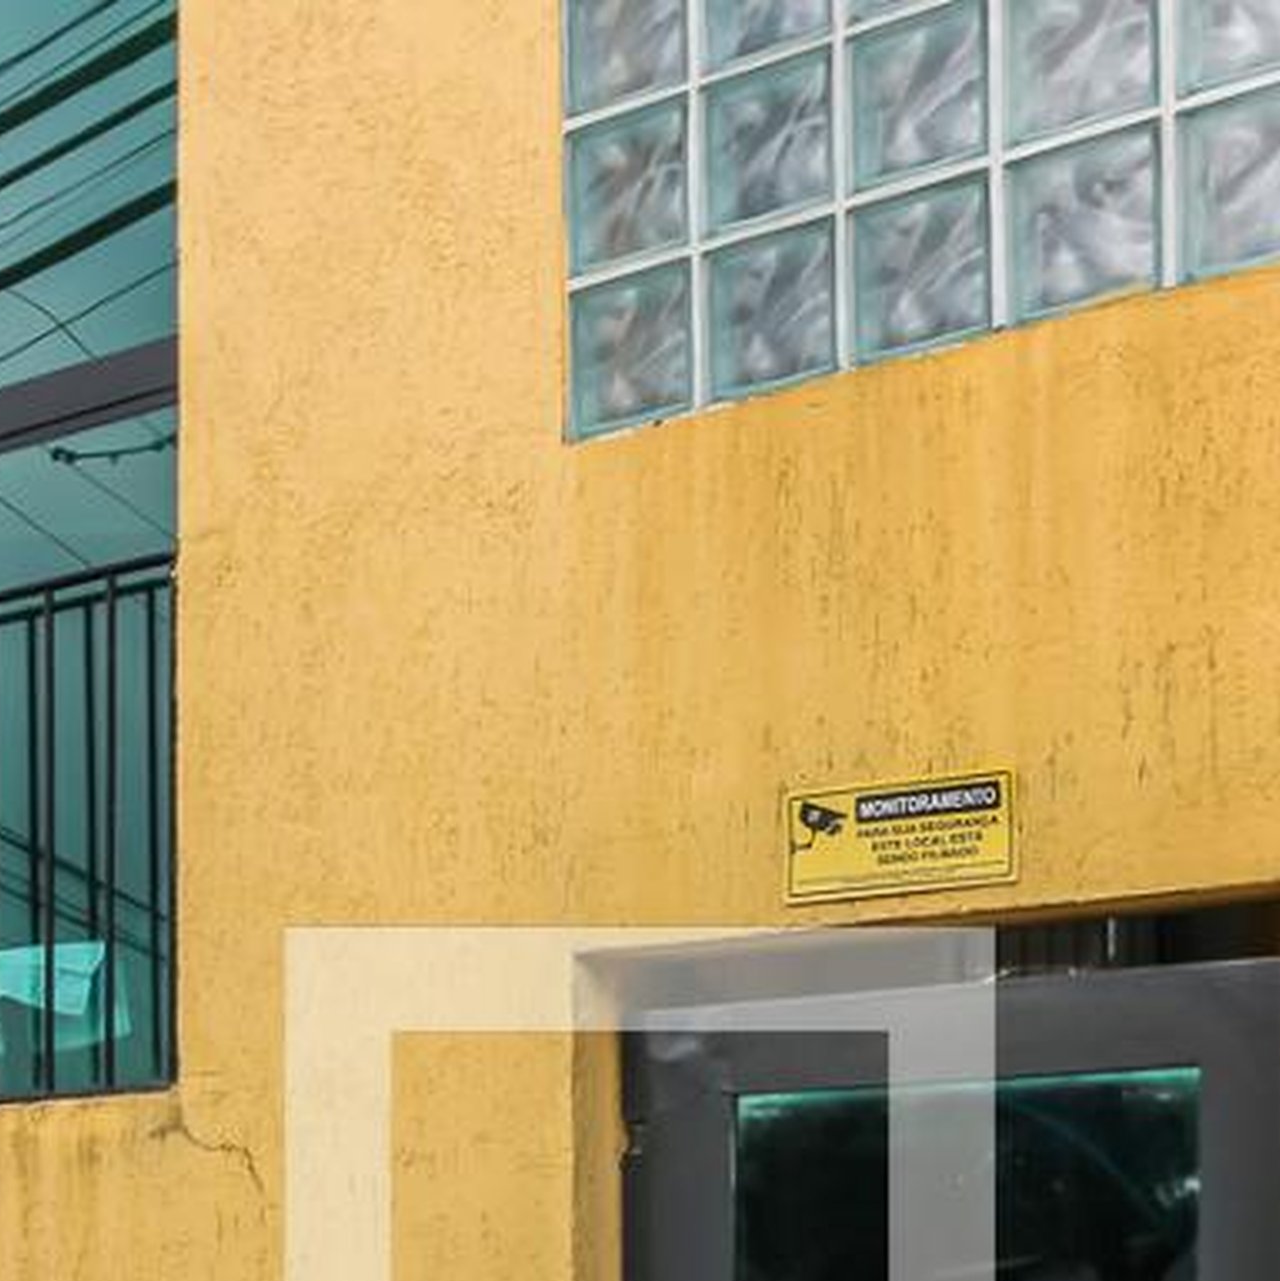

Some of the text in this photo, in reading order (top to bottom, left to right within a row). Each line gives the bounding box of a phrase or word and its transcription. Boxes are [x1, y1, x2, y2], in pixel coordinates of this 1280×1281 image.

[858, 786, 996, 818] MONITORAMENTO
[856, 826, 889, 838] PARA
[892, 823, 917, 836] SUA
[872, 839, 901, 852] ESTE
[905, 835, 946, 849] LOCAL
[877, 850, 919, 865] SENDO
